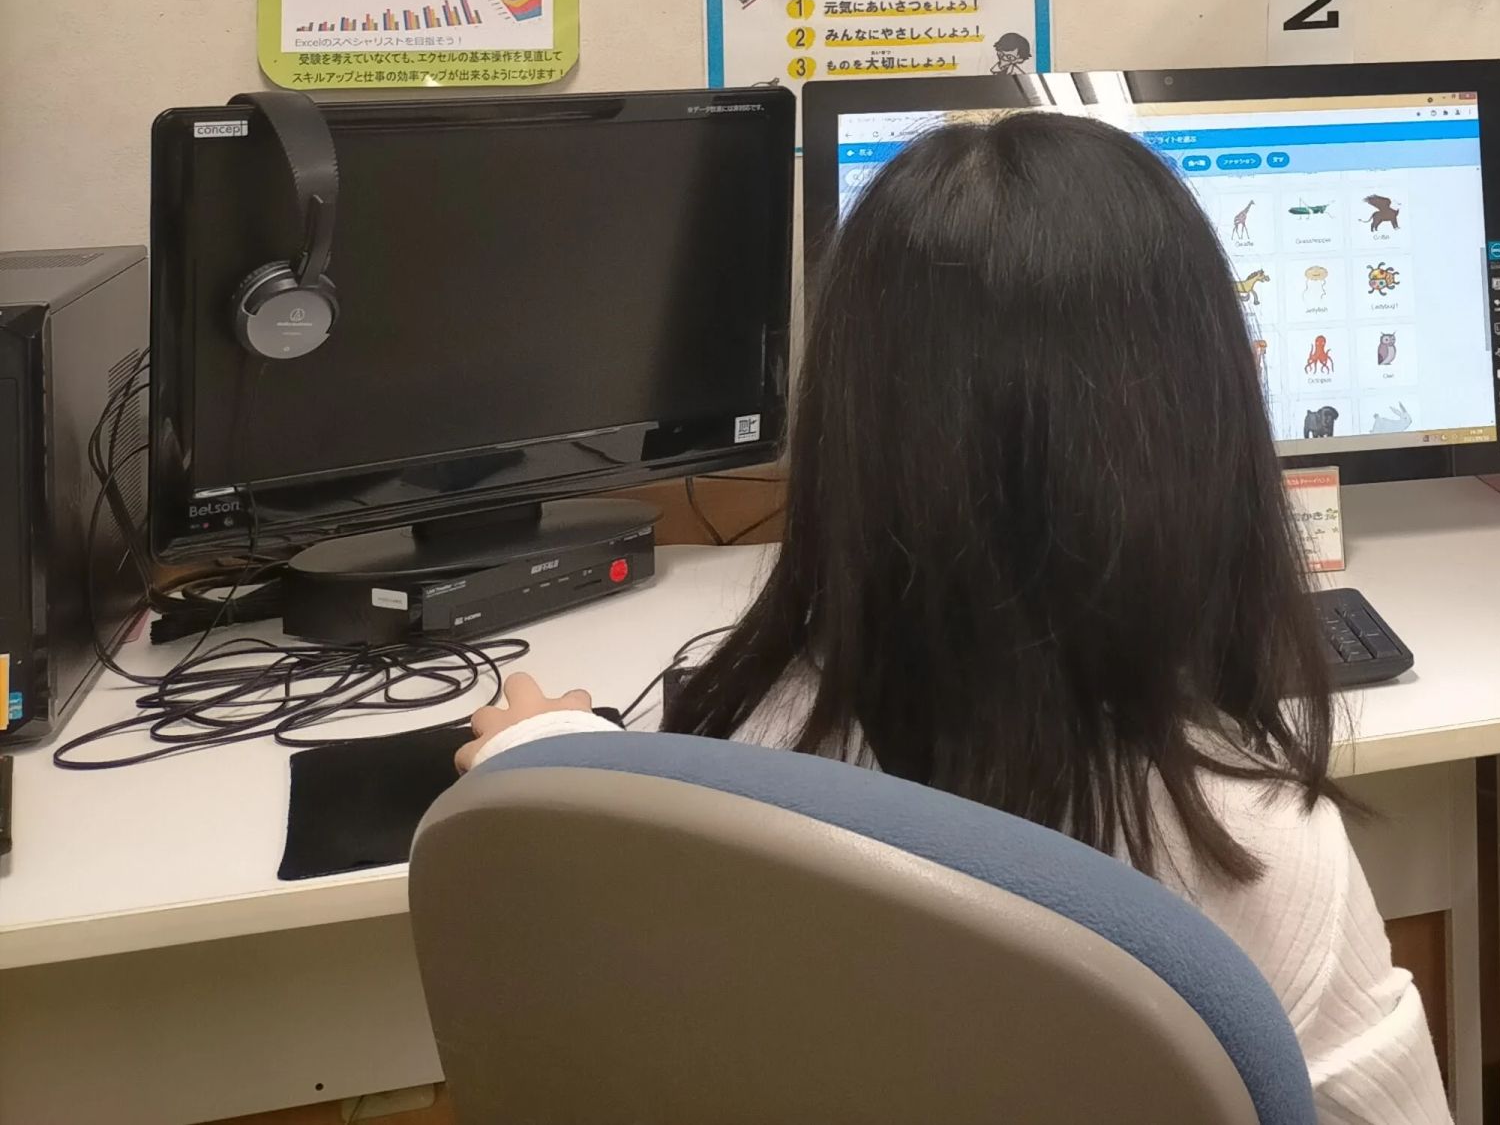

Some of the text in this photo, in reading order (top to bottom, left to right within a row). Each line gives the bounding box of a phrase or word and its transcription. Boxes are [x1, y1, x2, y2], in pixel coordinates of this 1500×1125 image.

[824, 25, 982, 42] みんなにやさしくしよう!
[826, 55, 958, 72] ものを大切にしよう!
